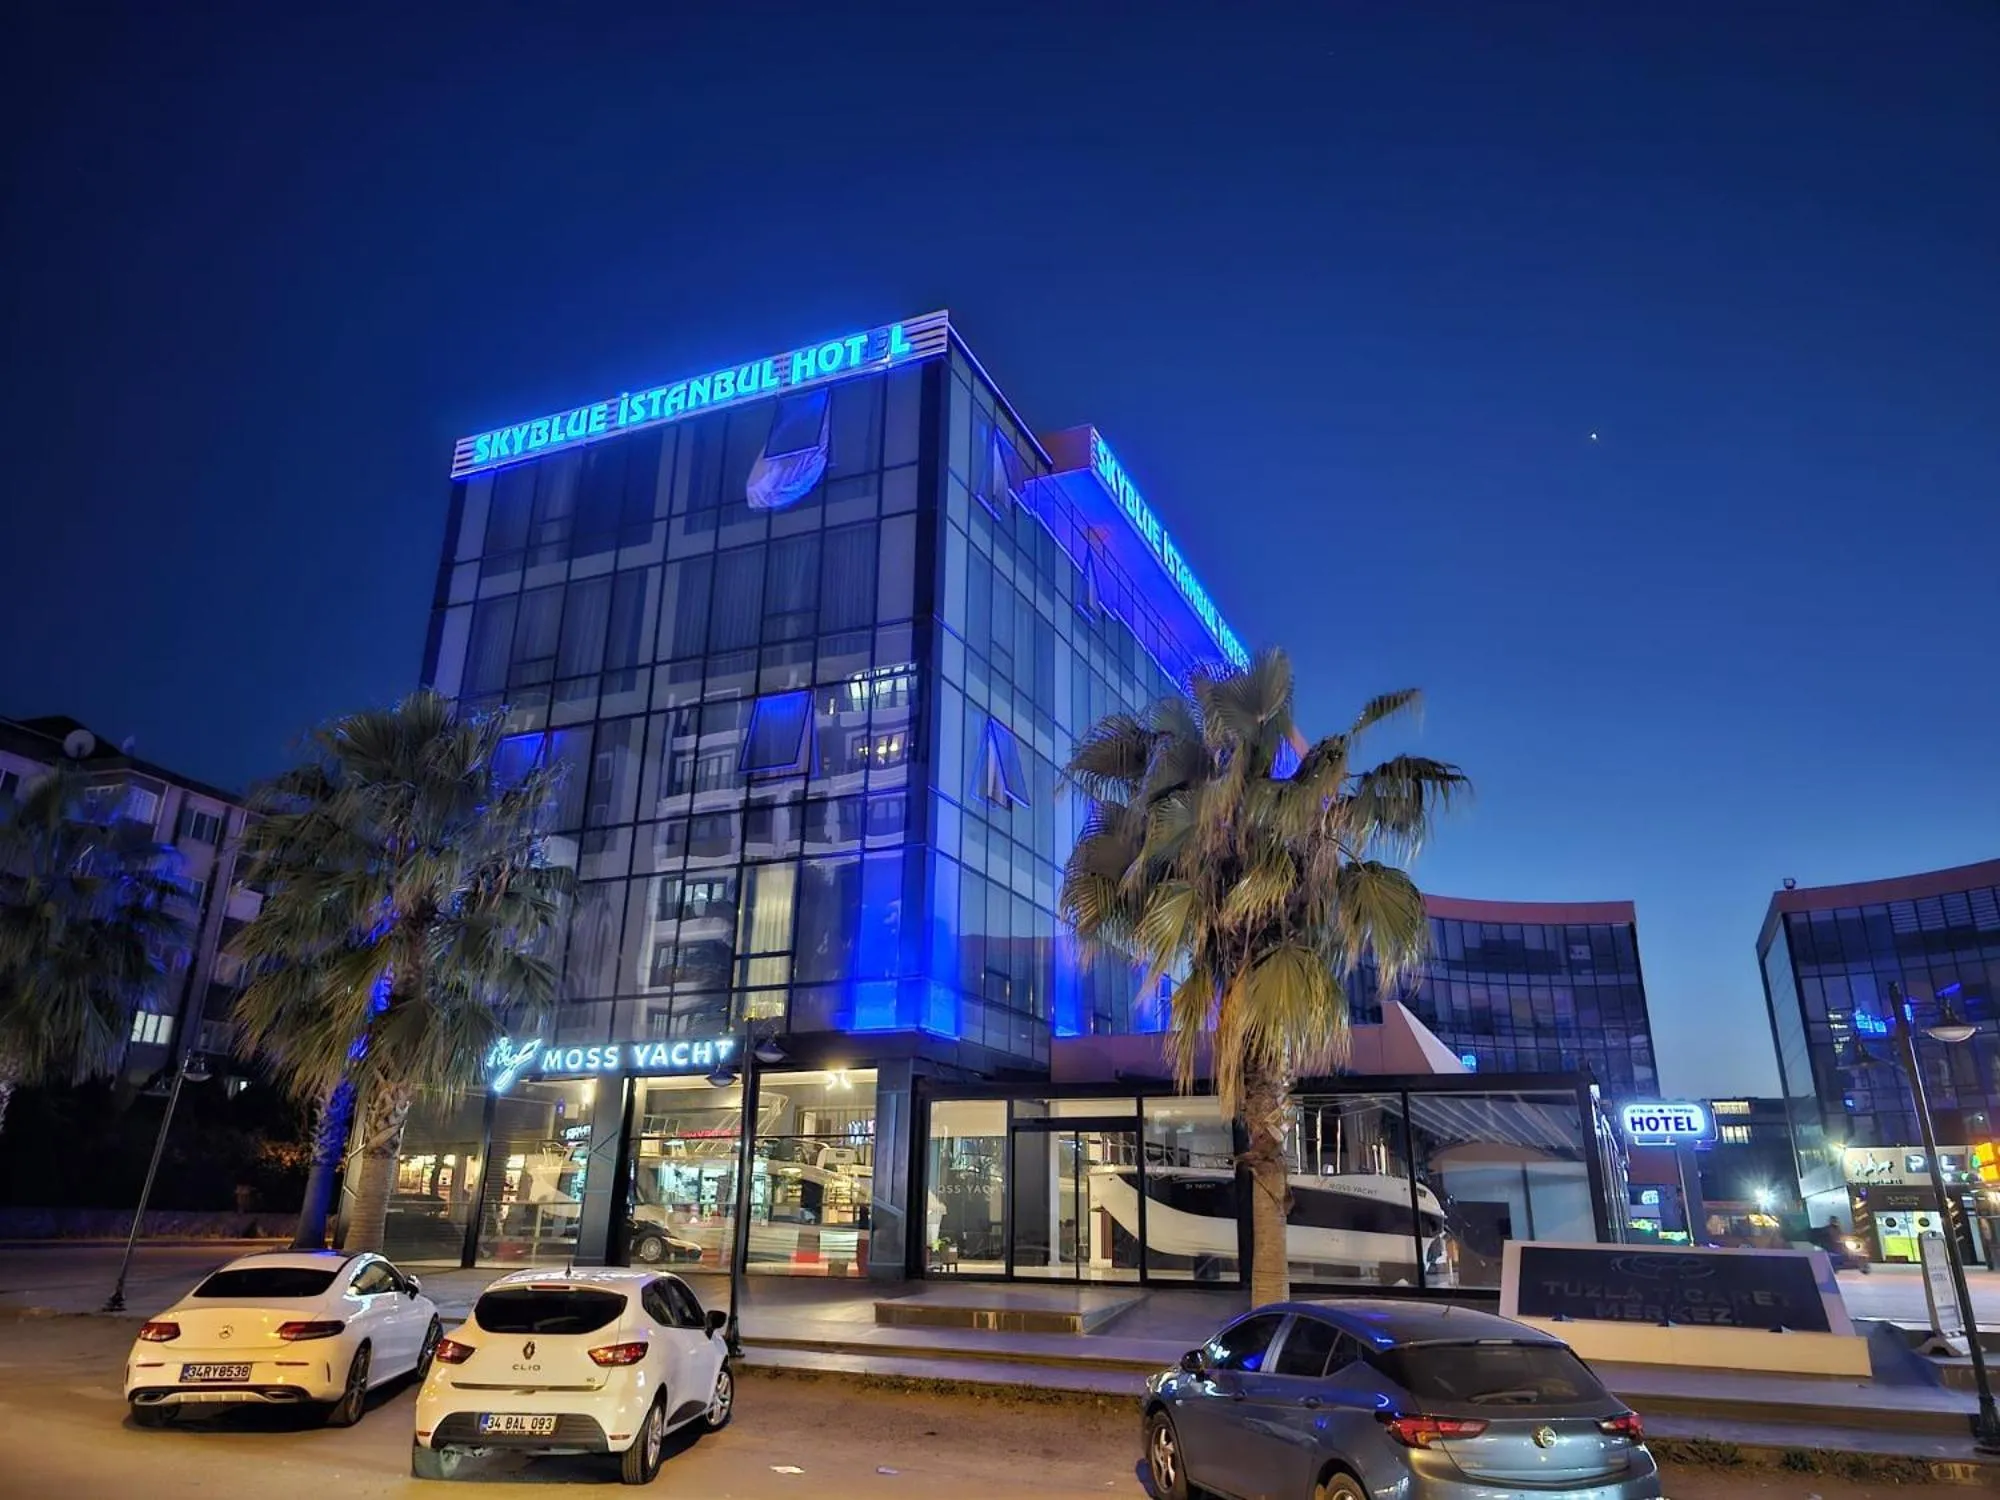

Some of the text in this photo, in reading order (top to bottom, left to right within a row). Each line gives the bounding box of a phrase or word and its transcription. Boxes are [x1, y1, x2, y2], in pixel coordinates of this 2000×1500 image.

[474, 324, 911, 463] SKYBLUE İSTANBUL HOTEL
[1098, 439, 1162, 556] SKYBLUE
[541, 1046, 621, 1071] MOSS
[634, 1039, 735, 1068] YACHT
[1630, 1115, 1698, 1132] HOTEL
[1541, 1279, 1644, 1301] TUZLA
[487, 1417, 554, 1430] 34 BAL 093
